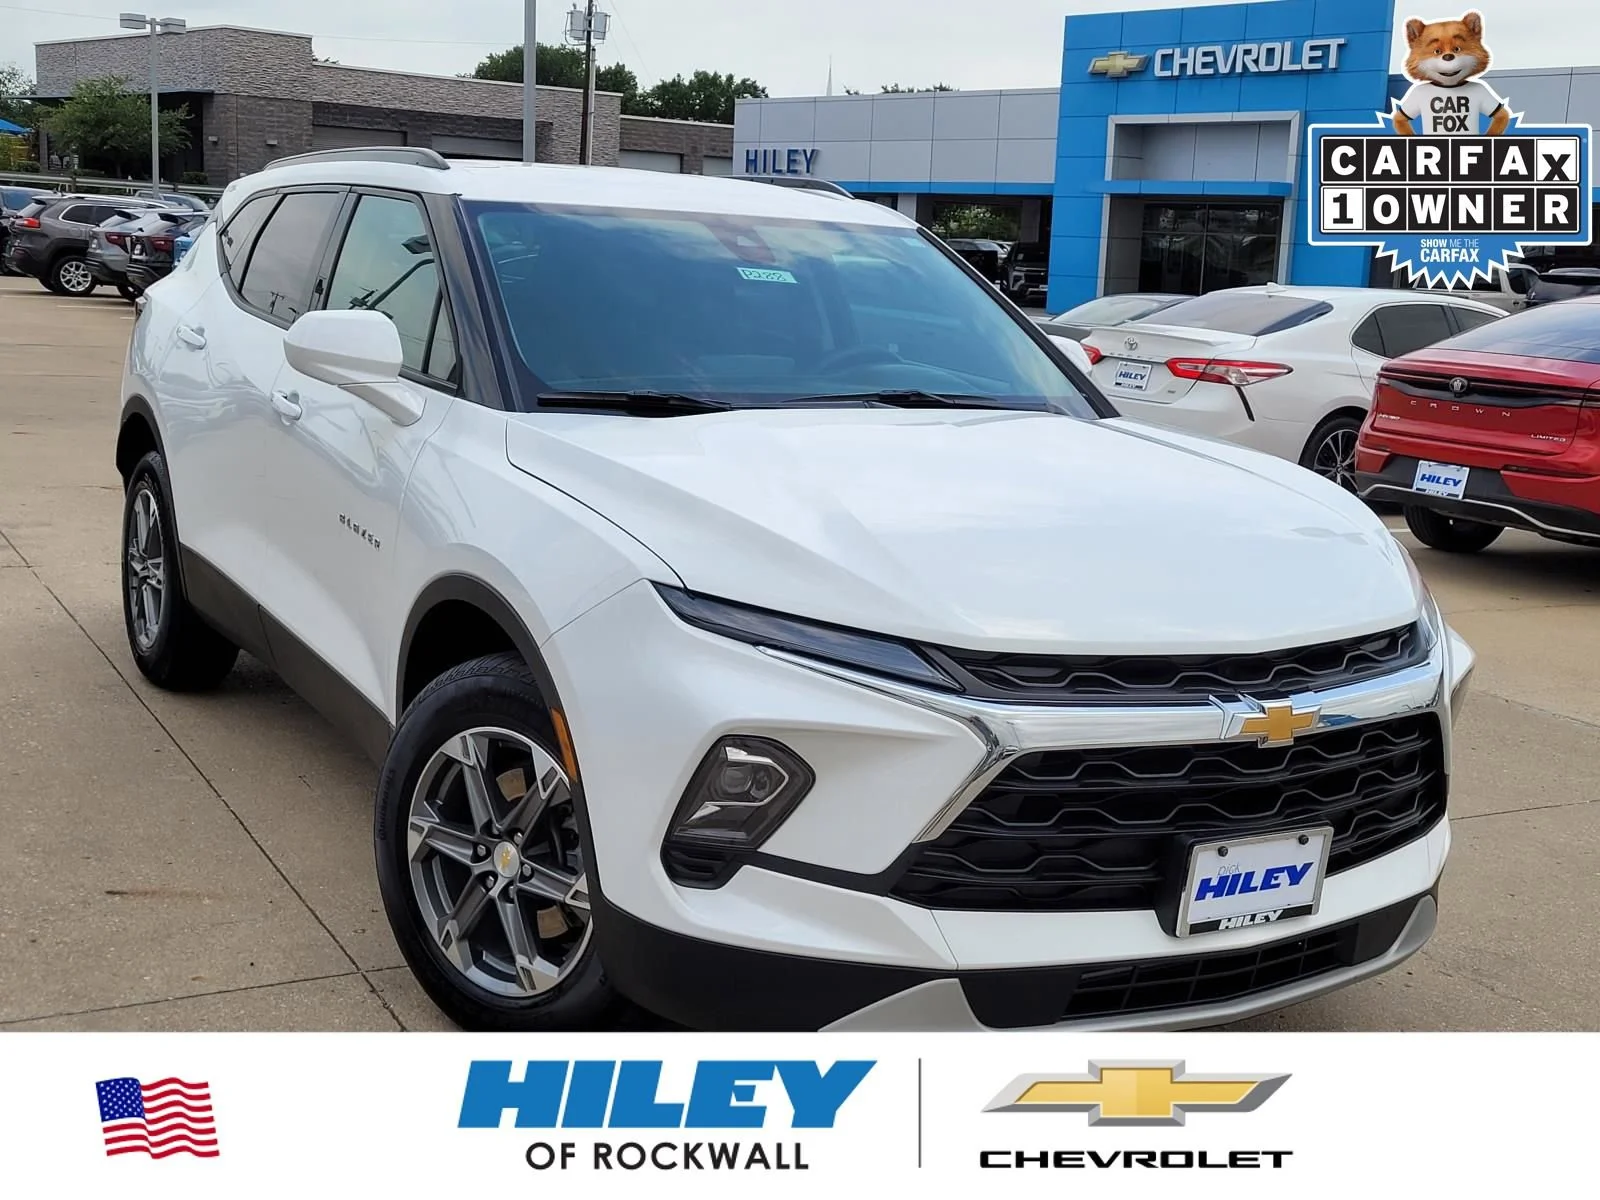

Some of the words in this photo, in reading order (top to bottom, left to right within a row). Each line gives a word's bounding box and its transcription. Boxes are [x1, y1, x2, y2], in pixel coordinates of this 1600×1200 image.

[1154, 38, 1346, 78] CHEVROLET
[745, 148, 817, 174] HILEY
[1118, 370, 1147, 381] HILEY
[1410, 400, 1511, 417] CROWN
[1530, 433, 1567, 443] LIMITED
[1420, 473, 1463, 487] HILEY
[1194, 861, 1314, 901] HILEY
[1218, 909, 1284, 931] HILEY
